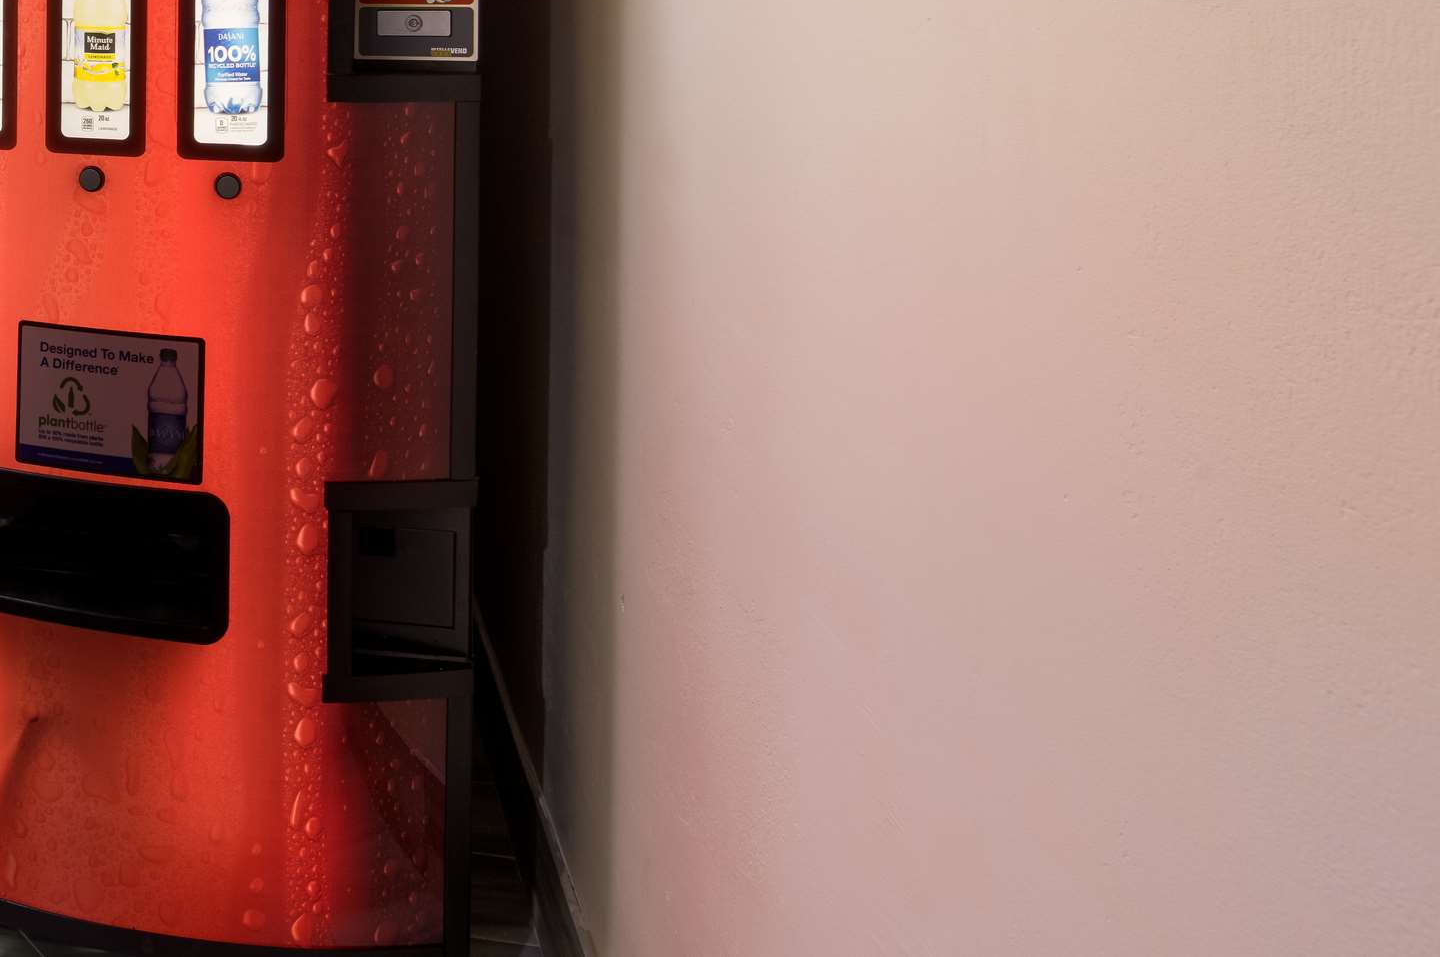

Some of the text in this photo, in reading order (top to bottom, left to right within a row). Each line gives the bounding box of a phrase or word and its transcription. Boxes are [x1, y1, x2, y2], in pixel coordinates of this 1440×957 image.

[86, 35, 113, 44] Minute
[218, 32, 246, 41] DASANI
[90, 43, 111, 51] Maid
[207, 45, 256, 62] 100%
[39, 341, 154, 364] Designed To Make
[40, 357, 118, 376] A Difference
[38, 414, 104, 433] plantbottle
